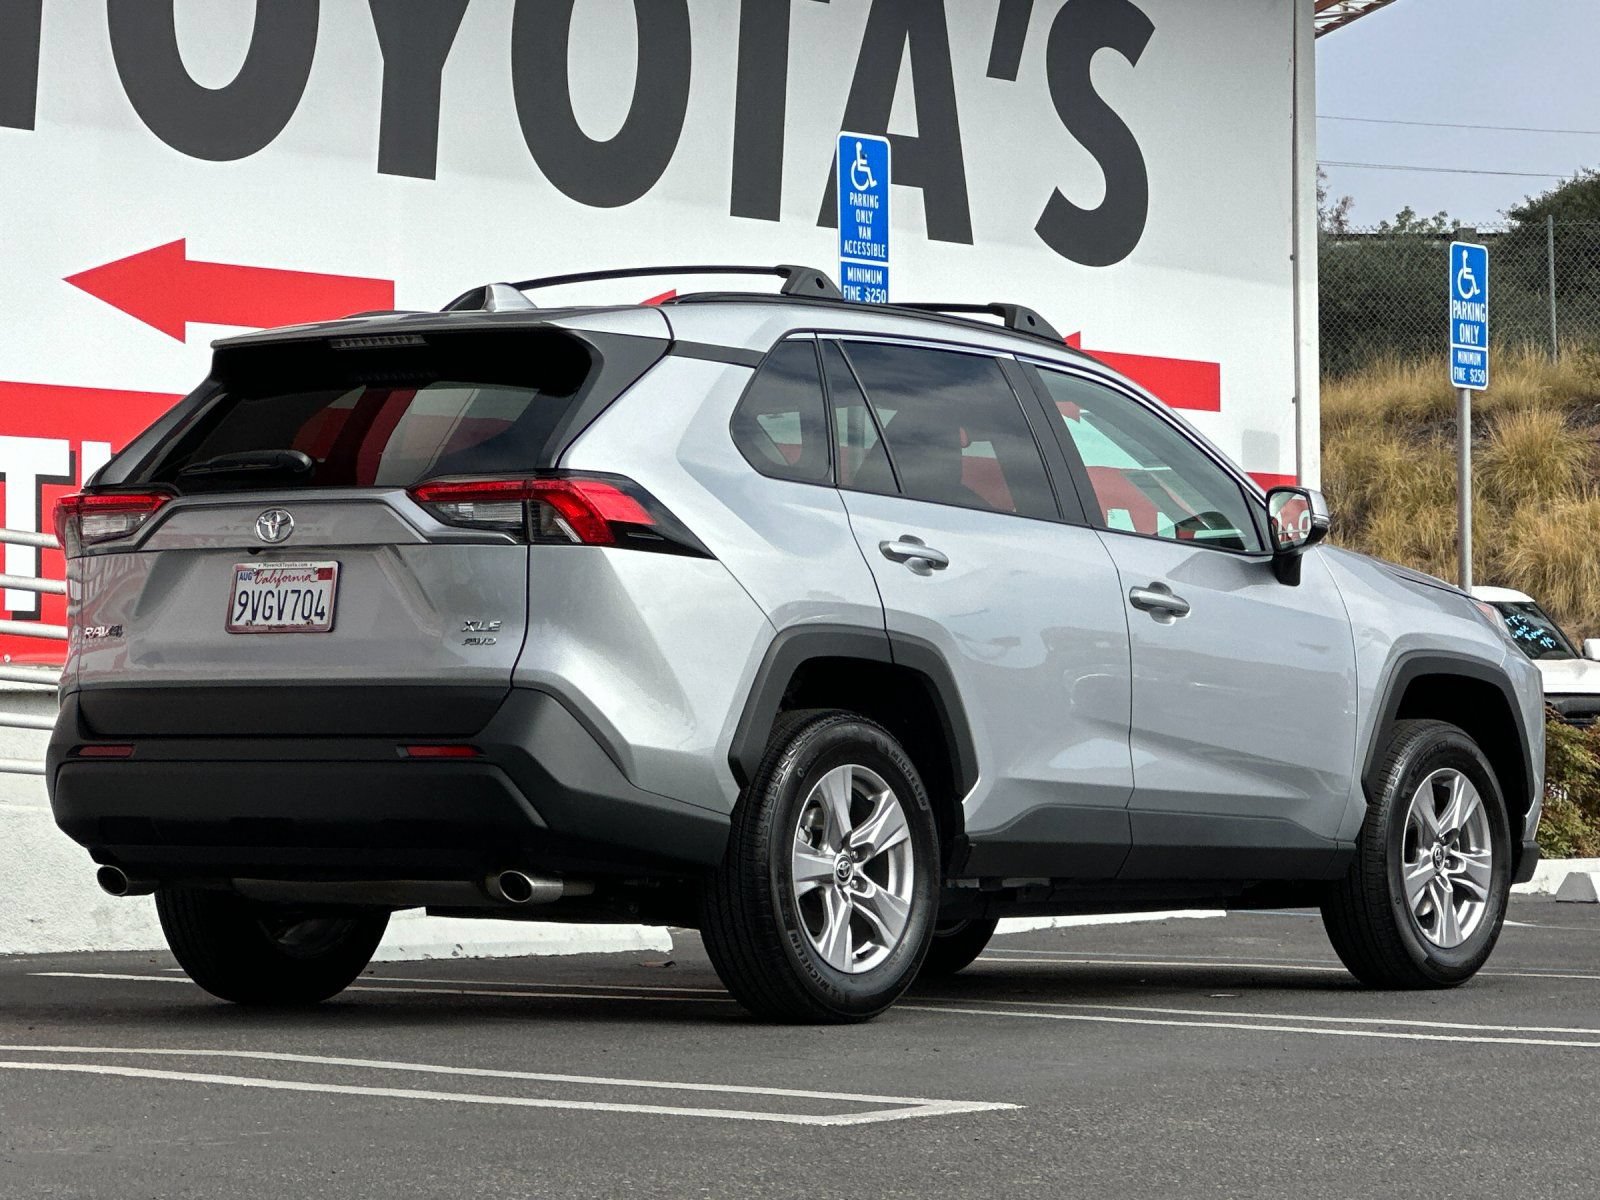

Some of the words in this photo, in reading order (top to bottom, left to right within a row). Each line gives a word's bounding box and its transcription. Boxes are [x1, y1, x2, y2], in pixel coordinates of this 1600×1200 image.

[849, 192, 880, 210] PARKING
[855, 211, 874, 225] ONLY
[857, 227, 872, 240] VAN
[843, 240, 886, 258] ACCESSIBLE
[847, 266, 883, 285] MINIMUM
[843, 286, 862, 301] FINE
[865, 287, 887, 304] $250
[1452, 299, 1486, 323] PARKING
[1459, 323, 1480, 345] ONLY
[1457, 350, 1482, 366] MINIMUM
[1453, 366, 1466, 382] FINE
[1469, 368, 1486, 384] $250
[240, 570, 253, 580] AUG
[254, 569, 318, 589] California
[235, 589, 326, 621] 9VGV704
[84, 624, 124, 639] RAV4
[461, 620, 502, 632] XLE
[461, 637, 497, 646] AWD
[889, 749, 927, 807] MICHELIN
[790, 933, 831, 992] MICHELIN
